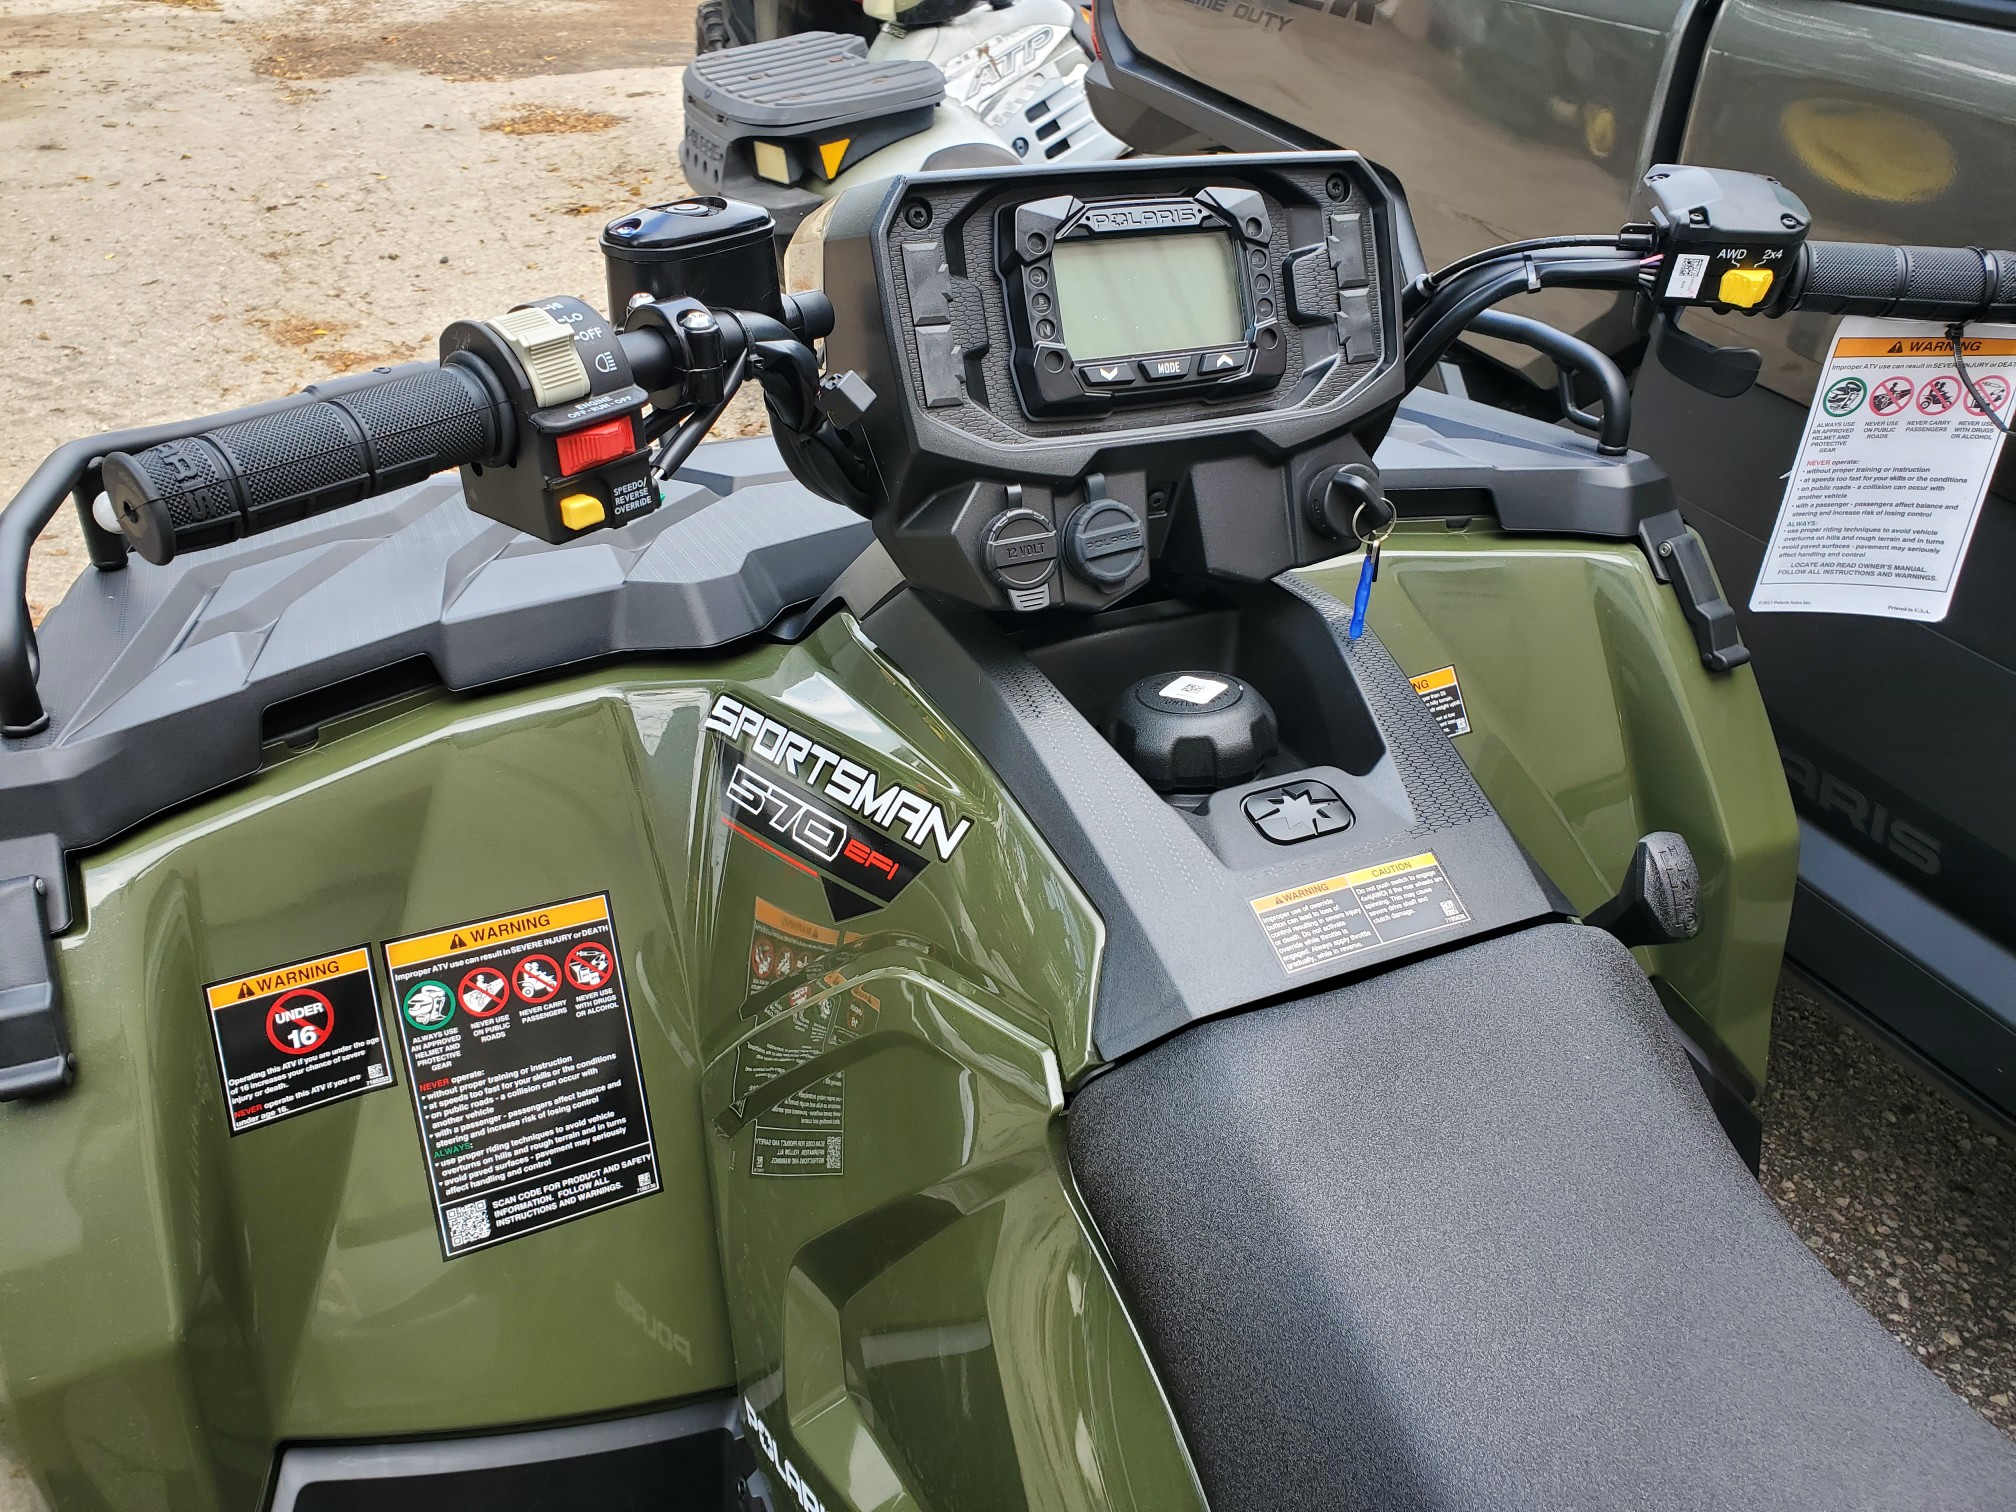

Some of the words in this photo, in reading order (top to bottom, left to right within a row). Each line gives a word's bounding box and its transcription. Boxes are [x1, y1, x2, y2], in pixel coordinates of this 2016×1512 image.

[1233, 3, 1295, 32] DUTY
[965, 26, 1053, 101] ATP
[1092, 208, 1197, 229] POLARIS
[1717, 249, 1747, 260] AWD
[1763, 249, 1783, 260] 2x4
[566, 312, 583, 323] LO
[579, 327, 602, 342] OFF
[1909, 341, 1982, 352] WARNNG
[1157, 362, 1181, 375] MODE
[575, 396, 613, 410] ENGINE
[613, 477, 648, 497] SPEEDO/
[614, 496, 652, 515] OVERRIDE
[615, 488, 649, 506] REVERSE
[1085, 529, 1141, 551] POLARIS
[1006, 546, 1017, 559] 12
[1018, 543, 1045, 557] VOLT
[1857, 562, 1892, 570] OWNER'S
[1893, 564, 1927, 572] MANUAL.
[1894, 572, 1936, 581] WARNINGS.
[704, 695, 971, 861] SPORTSMAN
[726, 763, 848, 862] 570
[843, 839, 900, 880] EFI
[1781, 751, 1943, 875] ARIS
[1371, 861, 1412, 877] CAUTION
[1282, 883, 1329, 901] WARNING
[469, 914, 550, 942] WARNING
[394, 967, 431, 981] Improper
[432, 962, 448, 972] ATV
[449, 959, 464, 968] use
[464, 956, 479, 964] can
[479, 949, 502, 961] result
[510, 939, 543, 953] SEVERE
[543, 932, 572, 945] INJURY
[581, 924, 608, 937] DEATH
[256, 960, 339, 992] WARNING
[574, 1000, 592, 1010] WITH
[592, 994, 616, 1005] DRUGS
[575, 991, 598, 1002] NEVER
[599, 987, 613, 996] USE
[275, 1002, 323, 1025] UNDER
[518, 1005, 542, 1016] NEVER
[543, 999, 566, 1010] CARRY
[521, 1007, 567, 1024] PASSENGERS
[587, 1001, 619, 1015] ALCOHOL
[470, 1018, 494, 1029] NEVER
[495, 1014, 510, 1023] USE
[473, 1028, 484, 1036] ON
[484, 1021, 510, 1033] PUBLIC
[287, 1026, 318, 1049] 16
[411, 1044, 421, 1052] AN
[422, 1034, 461, 1049] APPROVED
[412, 1031, 443, 1044] ALWAYS
[443, 1027, 458, 1036] USE
[480, 1031, 506, 1042] ROADS
[414, 1046, 443, 1059] HELMET
[445, 1042, 460, 1052] AND
[416, 1050, 461, 1067] PROTECTIVE
[227, 1070, 266, 1086] Operating
[266, 1065, 281, 1075] this
[281, 1059, 297, 1070] ATV
[297, 1057, 303, 1065] if
[303, 1055, 318, 1065] you
[318, 1051, 331, 1059] are
[331, 1044, 352, 1055] under
[365, 1037, 379, 1045] age
[431, 1060, 452, 1071] GEAR
[229, 1086, 238, 1095] of
[239, 1083, 249, 1092] 16
[249, 1073, 287, 1089] increases
[287, 1067, 304, 1079] your
[305, 1059, 332, 1072] chance
[332, 1055, 341, 1064] of
[341, 1049, 365, 1061] severe
[419, 1077, 449, 1092] NEVER
[450, 1069, 485, 1084] operate:
[426, 1085, 458, 1100] without
[459, 1079, 486, 1093] proper
[487, 1070, 519, 1084] training
[519, 1067, 528, 1075] or
[529, 1055, 572, 1072] instruction
[231, 1093, 253, 1104] injury
[254, 1089, 262, 1097] or
[264, 1082, 288, 1094] death.
[233, 1104, 262, 1118] NEVER
[263, 1095, 294, 1109] operate
[294, 1090, 310, 1099] this
[310, 1083, 326, 1094] ATV
[326, 1081, 332, 1089] if
[333, 1078, 348, 1088] you
[348, 1074, 361, 1082] are
[235, 1115, 259, 1127] under
[260, 1110, 276, 1119] age
[276, 1105, 289, 1113] 16.
[433, 1142, 473, 1158] ALWAYS:
[492, 1195, 516, 1208] SCAN
[517, 1187, 542, 1201] CODE
[543, 1181, 561, 1193] FOR
[561, 1168, 601, 1187] PRODUCT
[603, 1163, 620, 1174] AND
[621, 1153, 651, 1168] SAFETY
[493, 1193, 554, 1218] INFORMATION.
[557, 1181, 592, 1198] FOLLOW
[593, 1176, 610, 1187] ALL
[495, 1202, 557, 1227] INSTRUCTIONS
[559, 1196, 576, 1207] AND
[577, 1181, 623, 1201] WARNINGS.
